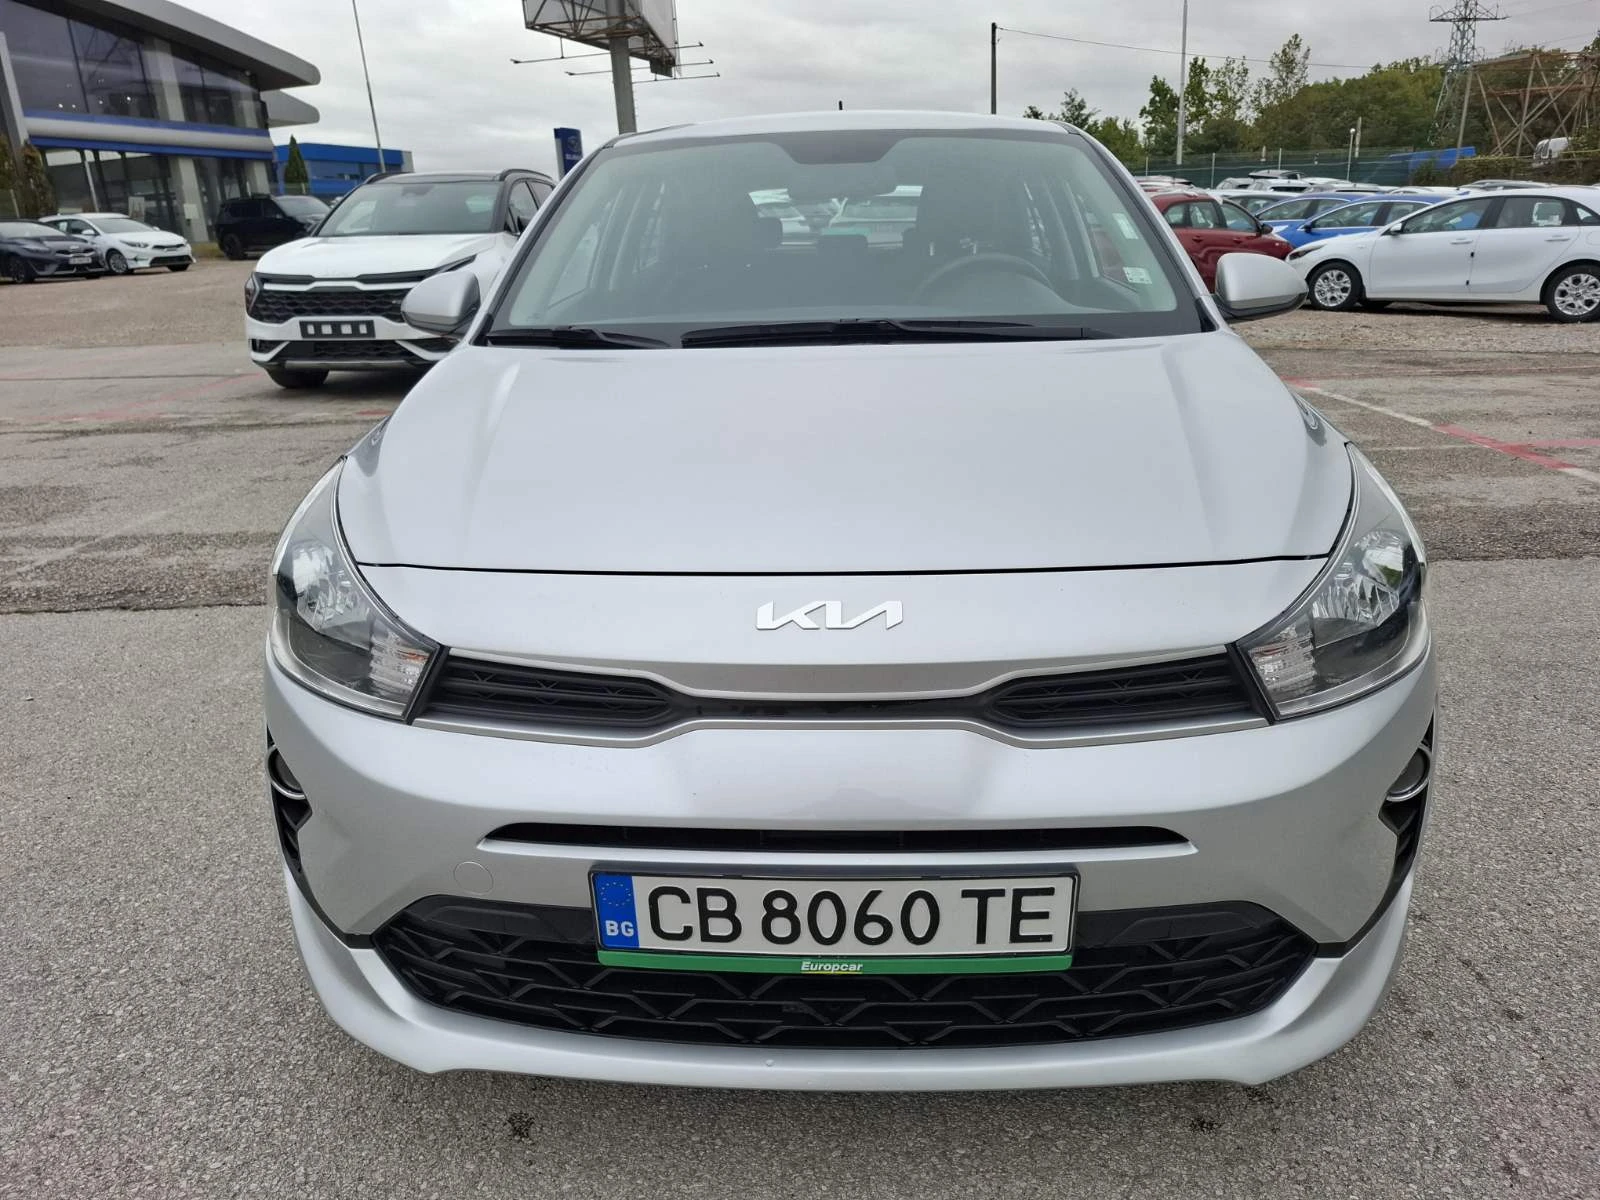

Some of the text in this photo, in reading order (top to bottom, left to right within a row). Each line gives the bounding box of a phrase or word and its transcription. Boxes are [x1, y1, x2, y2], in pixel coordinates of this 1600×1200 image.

[756, 600, 904, 630] KIA
[647, 885, 1057, 946] CB 8060 TE
[605, 920, 635, 937] BG
[801, 961, 864, 973] Europcar
